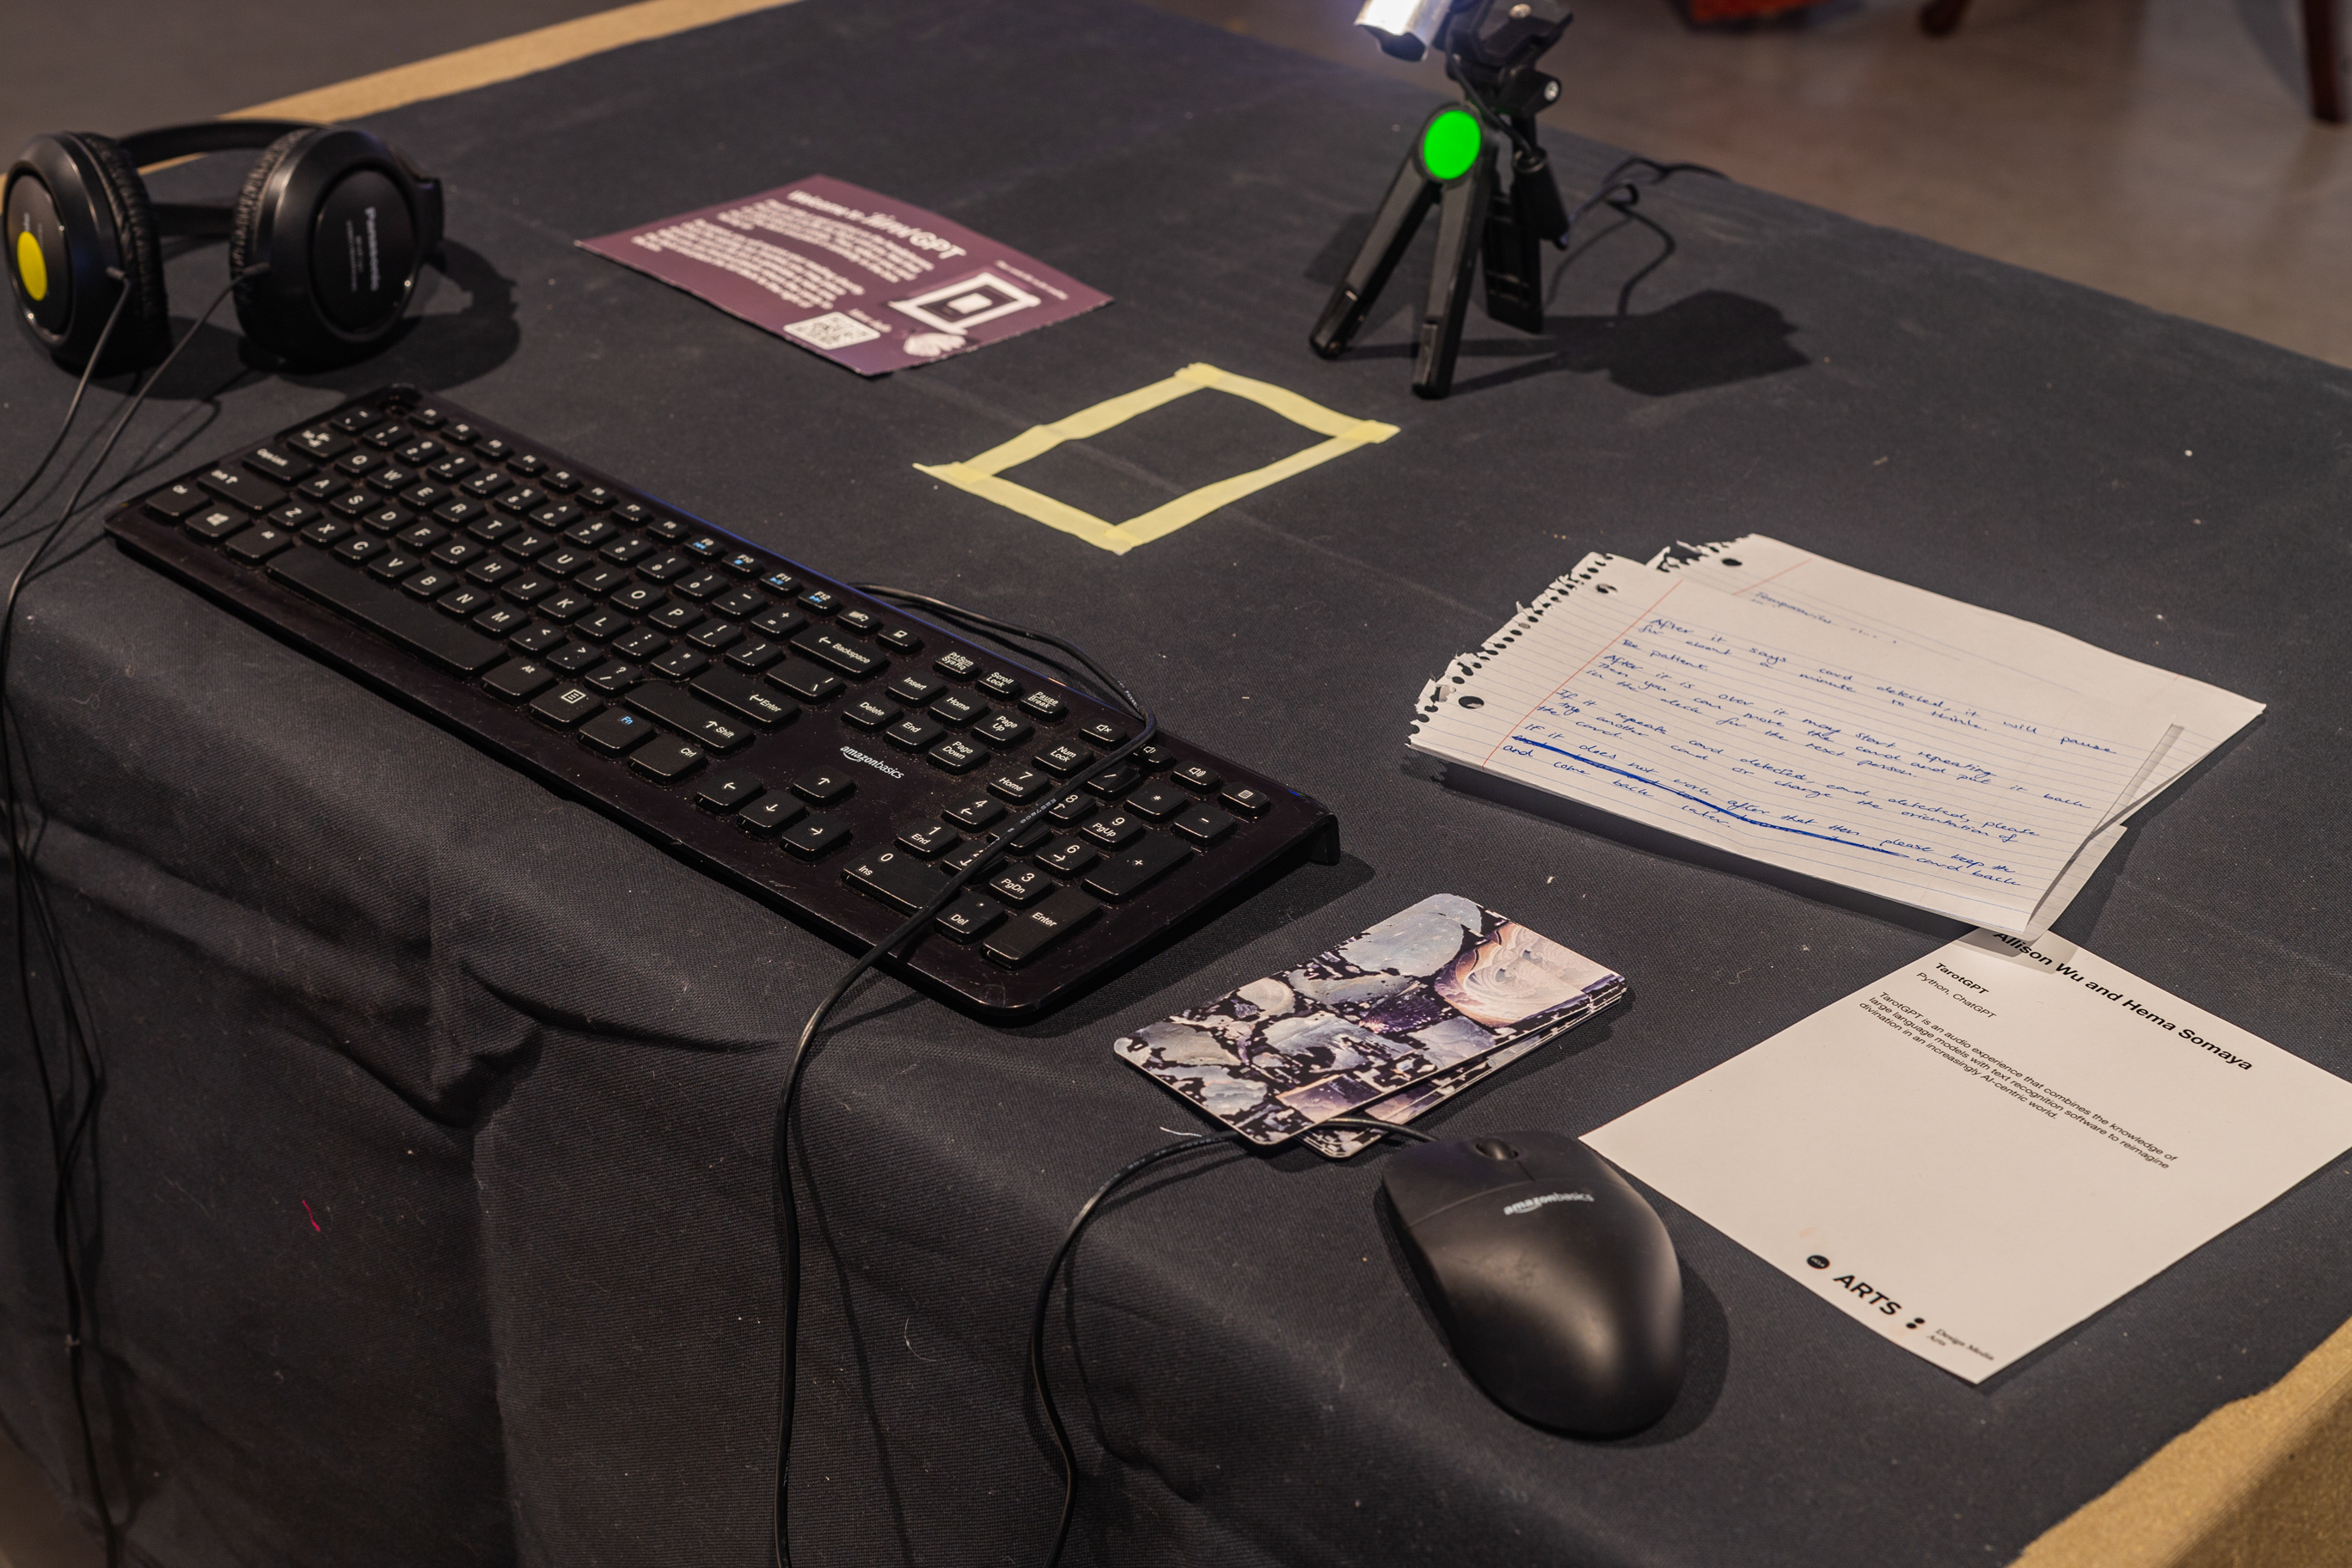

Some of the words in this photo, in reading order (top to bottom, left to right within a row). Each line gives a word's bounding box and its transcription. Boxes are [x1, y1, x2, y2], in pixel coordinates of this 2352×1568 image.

[1622, 639, 1638, 649] Be
[832, 643, 871, 664] Backspace
[1685, 640, 1730, 655] about
[1799, 673, 1856, 693] minute
[903, 677, 928, 690] Insert
[986, 676, 1005, 688] Lock
[989, 671, 1014, 684] Scroll
[1650, 619, 1688, 634] After
[1749, 647, 1786, 665] says
[1819, 668, 1853, 681] card
[2003, 721, 2037, 734] will
[2060, 737, 2116, 755] pause
[1027, 695, 1055, 708] Break
[1032, 691, 1059, 707] Pause
[1603, 654, 1644, 670] After
[1718, 694, 1754, 706] over
[1802, 719, 1841, 737] may
[759, 699, 781, 712] Enter
[859, 701, 885, 716] Delete
[946, 696, 971, 711] Home
[1536, 705, 1560, 716] the
[1585, 670, 1604, 680] in
[1616, 681, 1645, 693] the
[1660, 698, 1702, 714] deck
[1764, 730, 1788, 742] the
[621, 715, 634, 725] Fn
[902, 721, 922, 733] End
[992, 722, 1005, 732] Up
[995, 715, 1018, 728] Page
[715, 726, 735, 738] Shift
[1598, 663, 1628, 677] Then
[1638, 680, 1667, 692] you
[1693, 697, 1722, 710] can
[1743, 713, 1785, 727] move
[1807, 730, 1834, 743] the
[1855, 746, 1901, 761] card
[1910, 763, 1946, 774] and
[1956, 774, 1991, 785] put
[2043, 793, 2092, 809] back
[680, 747, 697, 757] Ctrl
[942, 745, 965, 760] Down
[946, 741, 974, 754] Page
[1055, 745, 1077, 758] Num
[840, 745, 904, 779] amazonbasics
[1050, 750, 1070, 763] Lock
[1556, 689, 1578, 700] If
[1614, 713, 1667, 735] repeats
[1688, 740, 1724, 755] card
[1825, 784, 1870, 797] card
[1981, 822, 2040, 838] please
[1503, 745, 1534, 757] and
[1553, 762, 1590, 775] come
[1612, 779, 1651, 797] back
[1549, 702, 1580, 716] try
[1596, 717, 1649, 737] another
[1670, 744, 1708, 761] card
[1773, 781, 1833, 799] change
[1856, 800, 1883, 810] the
[1901, 812, 1989, 836] orientation
[1999, 833, 2018, 843] of
[998, 777, 1024, 792] Home
[1578, 744, 1617, 760] does
[1626, 763, 1657, 774] not
[1673, 779, 1712, 796] work
[1726, 798, 1769, 817] after
[1780, 815, 1816, 825] that
[1828, 824, 1859, 836] then
[1879, 838, 1934, 852] please
[1951, 854, 1985, 873] keep
[1092, 822, 1117, 836] PgUp
[910, 833, 931, 845] End
[858, 865, 873, 876] Ins
[1915, 858, 1963, 872] card
[1971, 870, 2021, 886] back
[1001, 878, 1026, 894] PgDn
[950, 914, 970, 926] Del
[1032, 911, 1057, 927] Enter
[1935, 962, 1989, 994] TarotGPT
[1916, 971, 1950, 995] Python,
[1952, 993, 1997, 1018] ChatGPT
[1993, 933, 2053, 967] Allison
[2055, 962, 2085, 983] Wu
[2085, 982, 2124, 1001] and
[2122, 999, 2177, 1032] Hema
[2177, 1029, 2252, 1070] Somaya
[1859, 1002, 1909, 1031] divination
[1902, 1028, 1913, 1037] in
[1912, 1036, 1926, 1044] an
[1926, 1043, 1981, 1075] increasingly
[1980, 1075, 2028, 1102] AI-centric
[2028, 1100, 2058, 1119] world.
[1879, 991, 1924, 1019] TarotGPT
[1931, 1025, 1945, 1033] an
[1944, 1032, 1971, 1049] audio
[1971, 1047, 2024, 1078] experience
[2024, 1076, 2044, 1089] that
[2043, 1088, 2092, 1115] combines
[2092, 1113, 2109, 1125] the
[2109, 1123, 2164, 1155] knowledge
[1868, 996, 1893, 1014] large
[1892, 1011, 1935, 1038] language
[1933, 1037, 1969, 1058] models
[1970, 1057, 1991, 1070] with
[1990, 1069, 2011, 1081] text
[2010, 1080, 2064, 1112] recognition
[2064, 1110, 2107, 1135] software
[2108, 1133, 2119, 1142] to
[2119, 1141, 2170, 1169] reimagine
[1504, 1191, 1595, 1215] amazonbasics
[1833, 1275, 1902, 1315] ARTS
